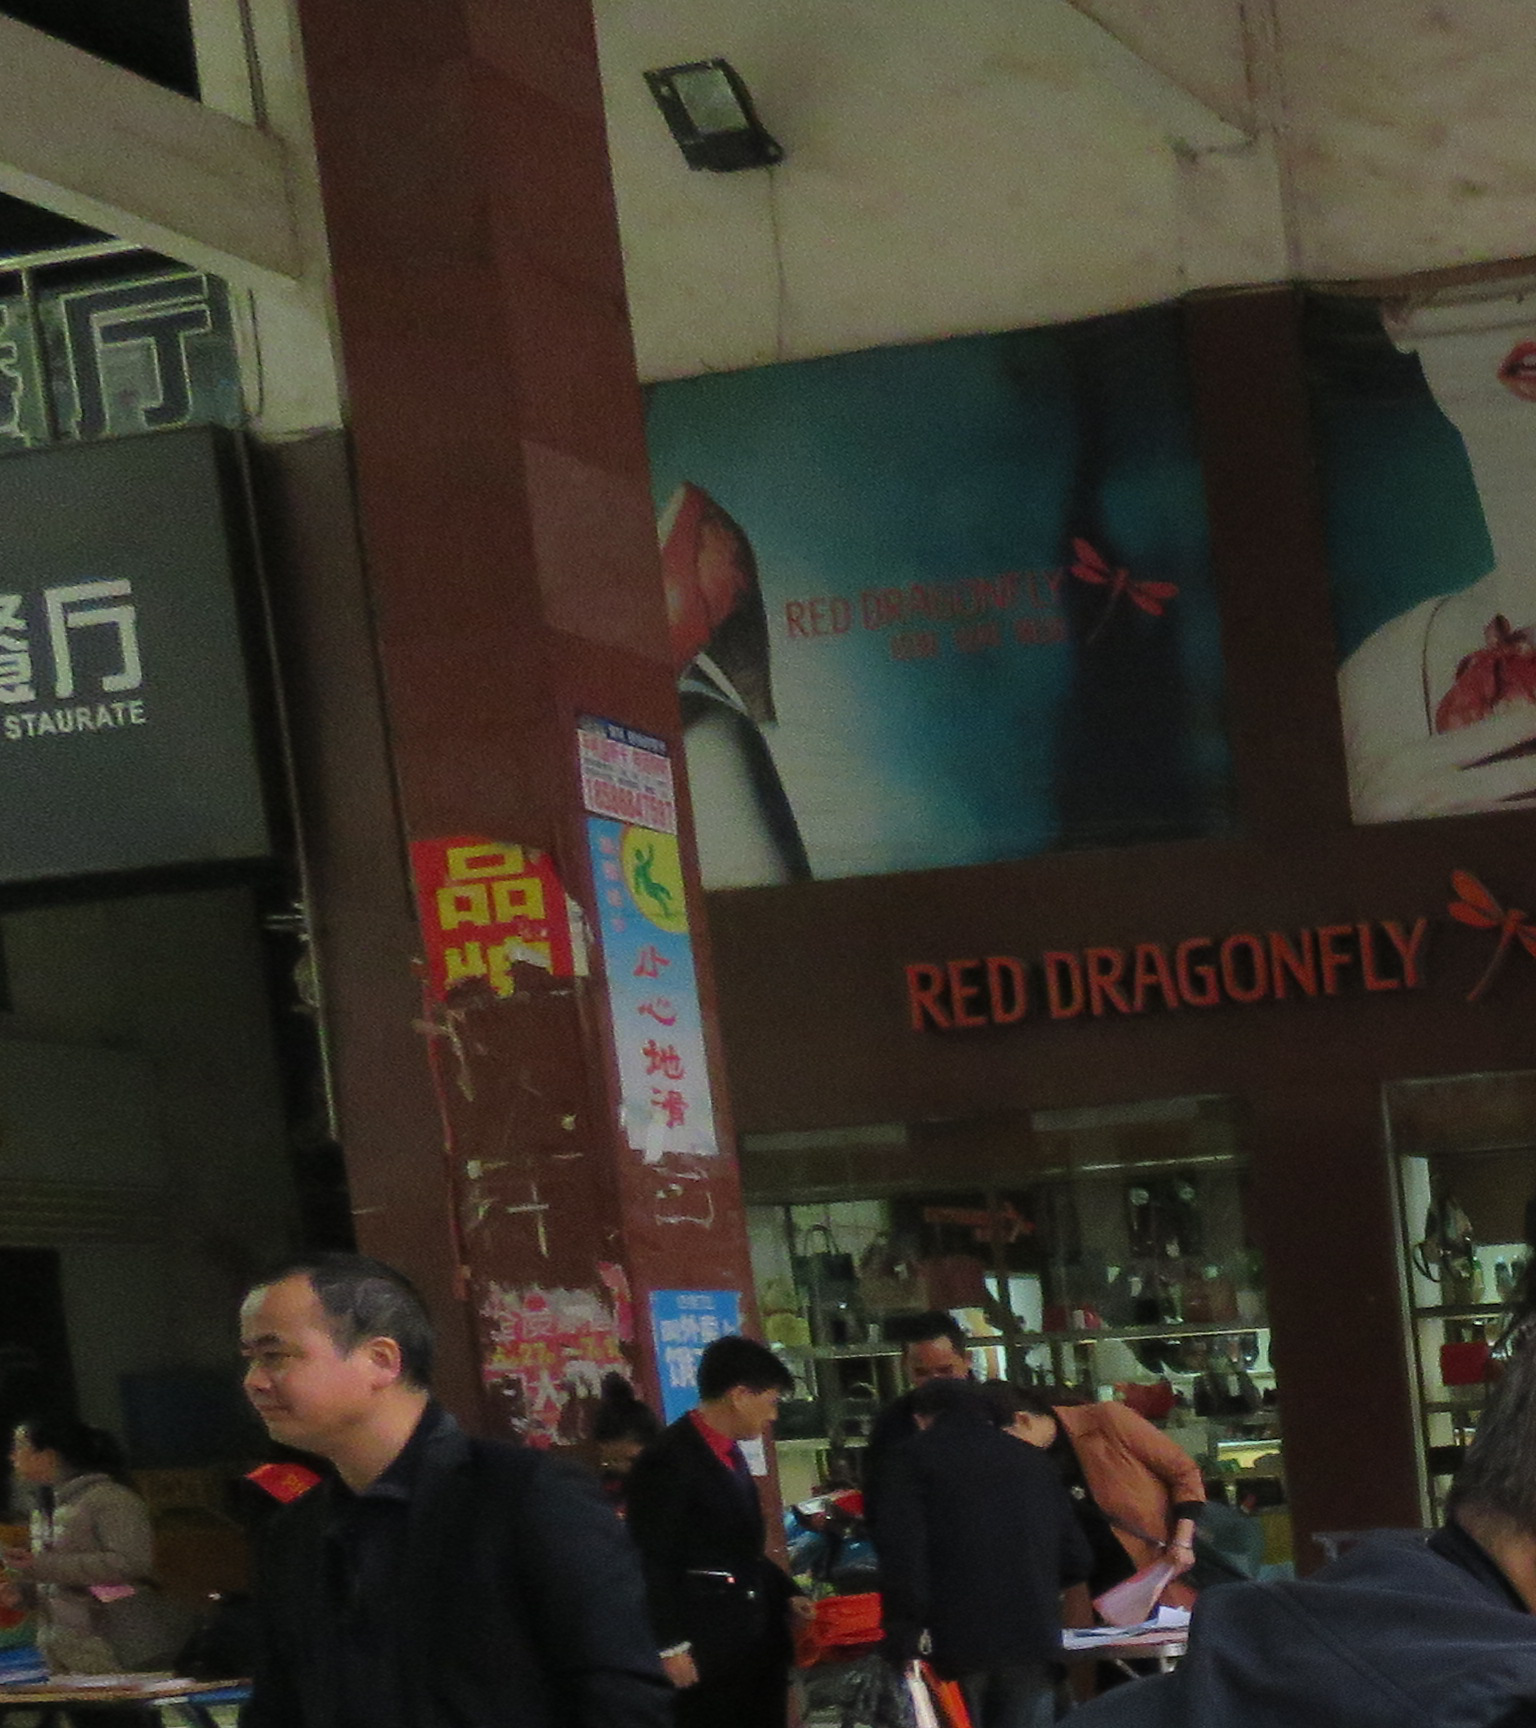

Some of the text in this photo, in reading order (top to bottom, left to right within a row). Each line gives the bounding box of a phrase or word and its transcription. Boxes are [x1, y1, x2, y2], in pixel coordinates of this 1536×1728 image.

[785, 597, 853, 637] RED
[4, 698, 148, 739] STAURATE
[905, 916, 1428, 1033] RED DRAGONFLY
